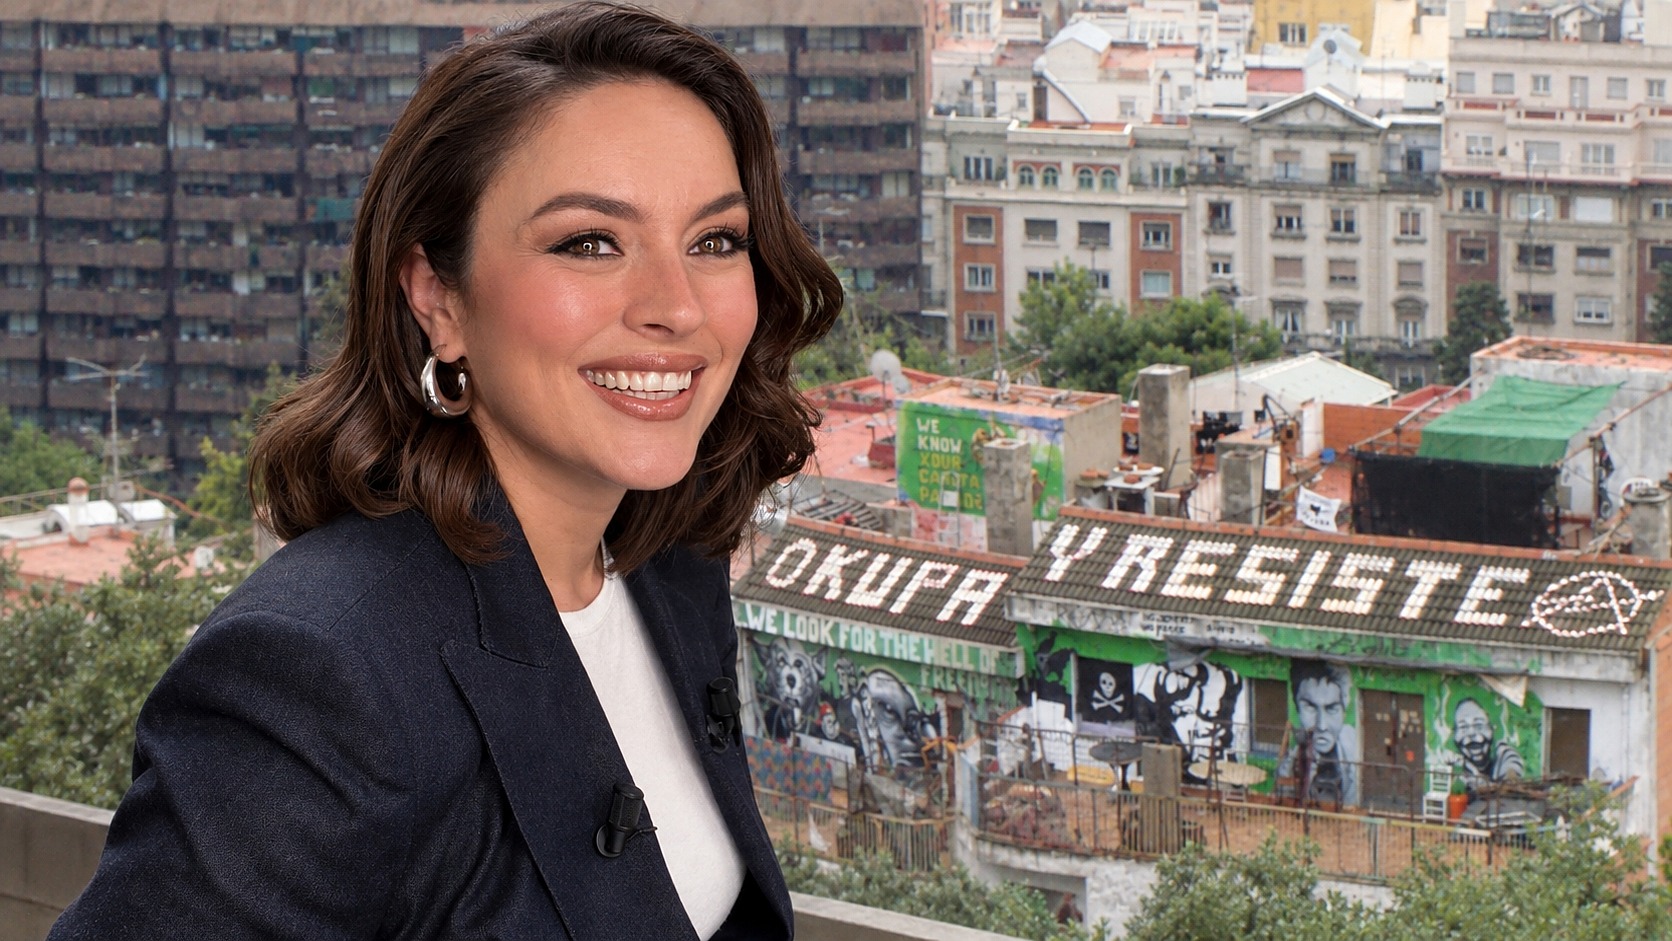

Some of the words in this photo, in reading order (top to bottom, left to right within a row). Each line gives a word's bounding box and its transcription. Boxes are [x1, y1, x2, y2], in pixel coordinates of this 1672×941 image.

[916, 417, 940, 434] WE
[917, 434, 962, 453] KNOW
[765, 537, 1009, 626] OKUPA
[1044, 524, 1108, 582] Y
[1101, 533, 1531, 626] RESISTE
[783, 610, 835, 648] LOOK
[838, 622, 877, 656] FOR
[879, 629, 921, 662] THE
[923, 637, 980, 673] HELL
